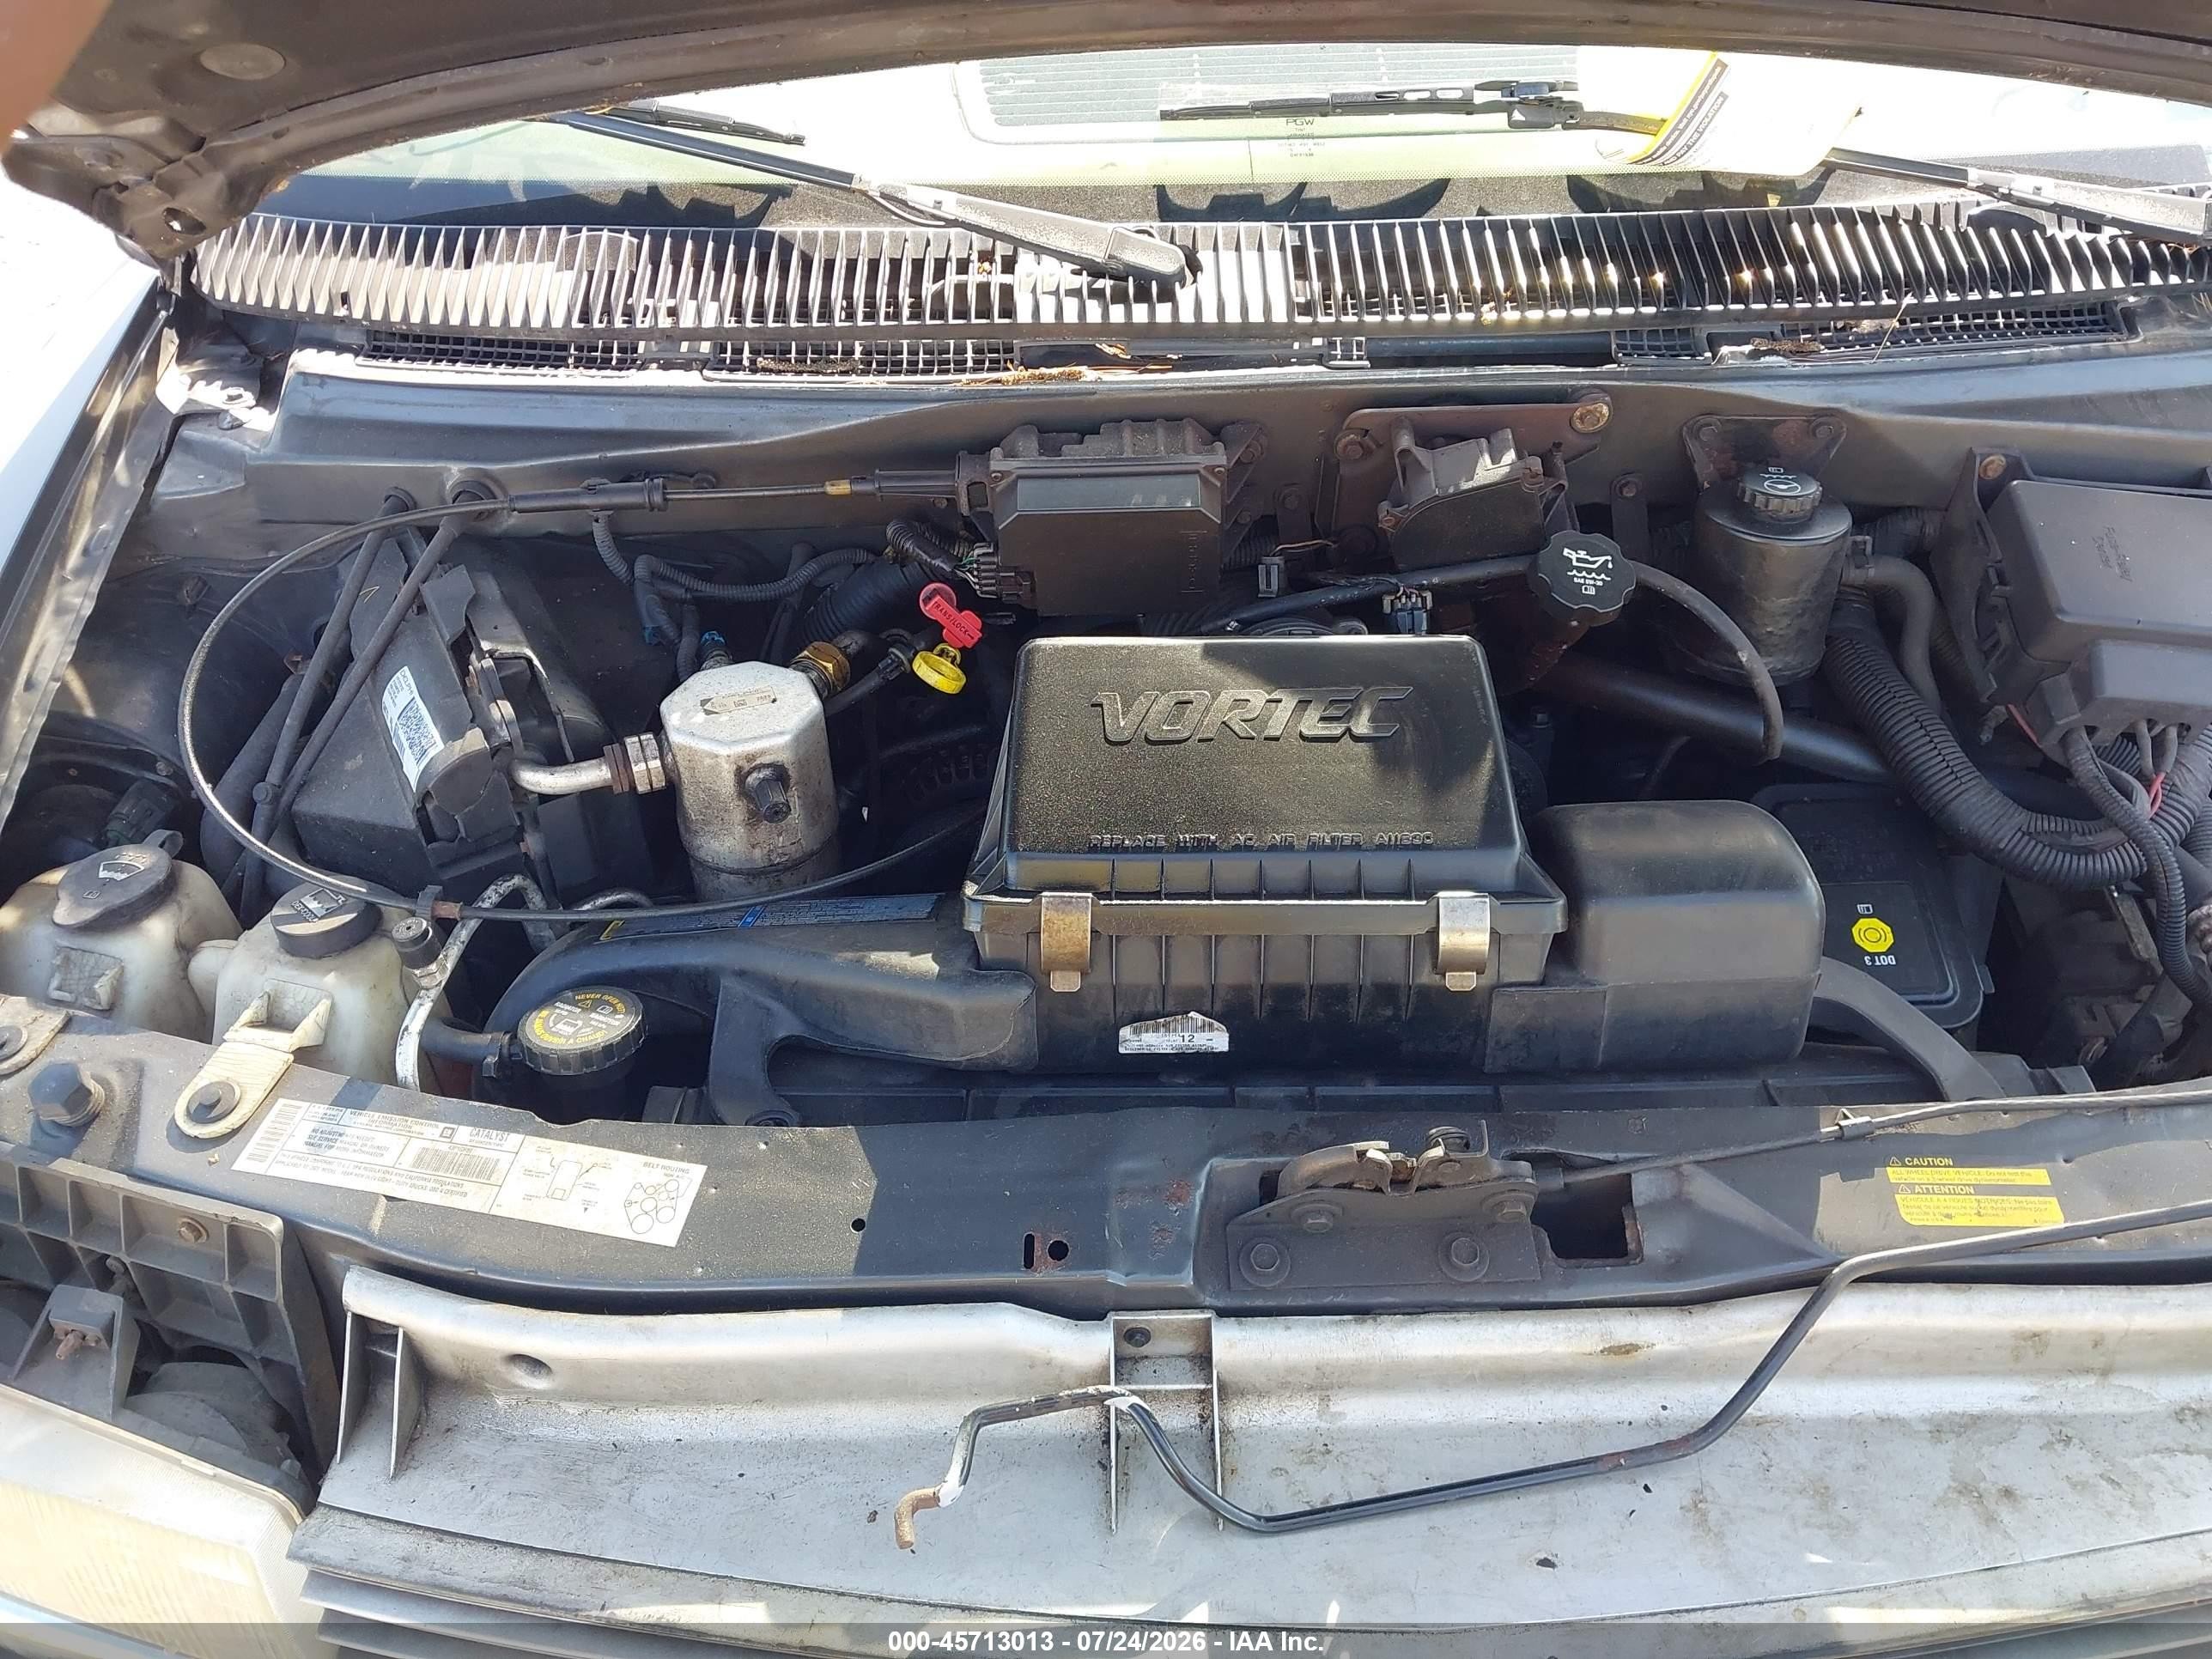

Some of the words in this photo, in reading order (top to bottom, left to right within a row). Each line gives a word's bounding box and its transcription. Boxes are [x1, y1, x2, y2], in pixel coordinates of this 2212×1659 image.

[1285, 118, 1315, 126] PGW
[1676, 145, 1689, 157] PAY
[1687, 133, 1700, 146] THE
[1697, 94, 1724, 132] VIOLATION
[399, 669, 415, 696] DELPHI
[1091, 687, 1413, 745] VORTEC
[1089, 834, 1166, 848] REPLACE
[1177, 833, 1218, 848] WITH
[1231, 832, 1255, 846] AC
[1268, 832, 1297, 846] AIR
[1305, 832, 1364, 846] FILTER
[1863, 955, 1873, 965] 3
[1874, 955, 1896, 965] DOT
[574, 992, 602, 1000] NEVER
[1181, 1034, 1195, 1043] 12
[349, 1110, 375, 1119] VEHICLE
[378, 1114, 409, 1124] EMISSION
[410, 1119, 440, 1129] CONTROL
[469, 1127, 510, 1142] CATALYST
[1905, 1157, 1954, 1167] CAUTION
[661, 1165, 690, 1175] ROUTING
[404, 1173, 431, 1182] CALIFORNIA
[1914, 1184, 1975, 1194] ATTENTION
